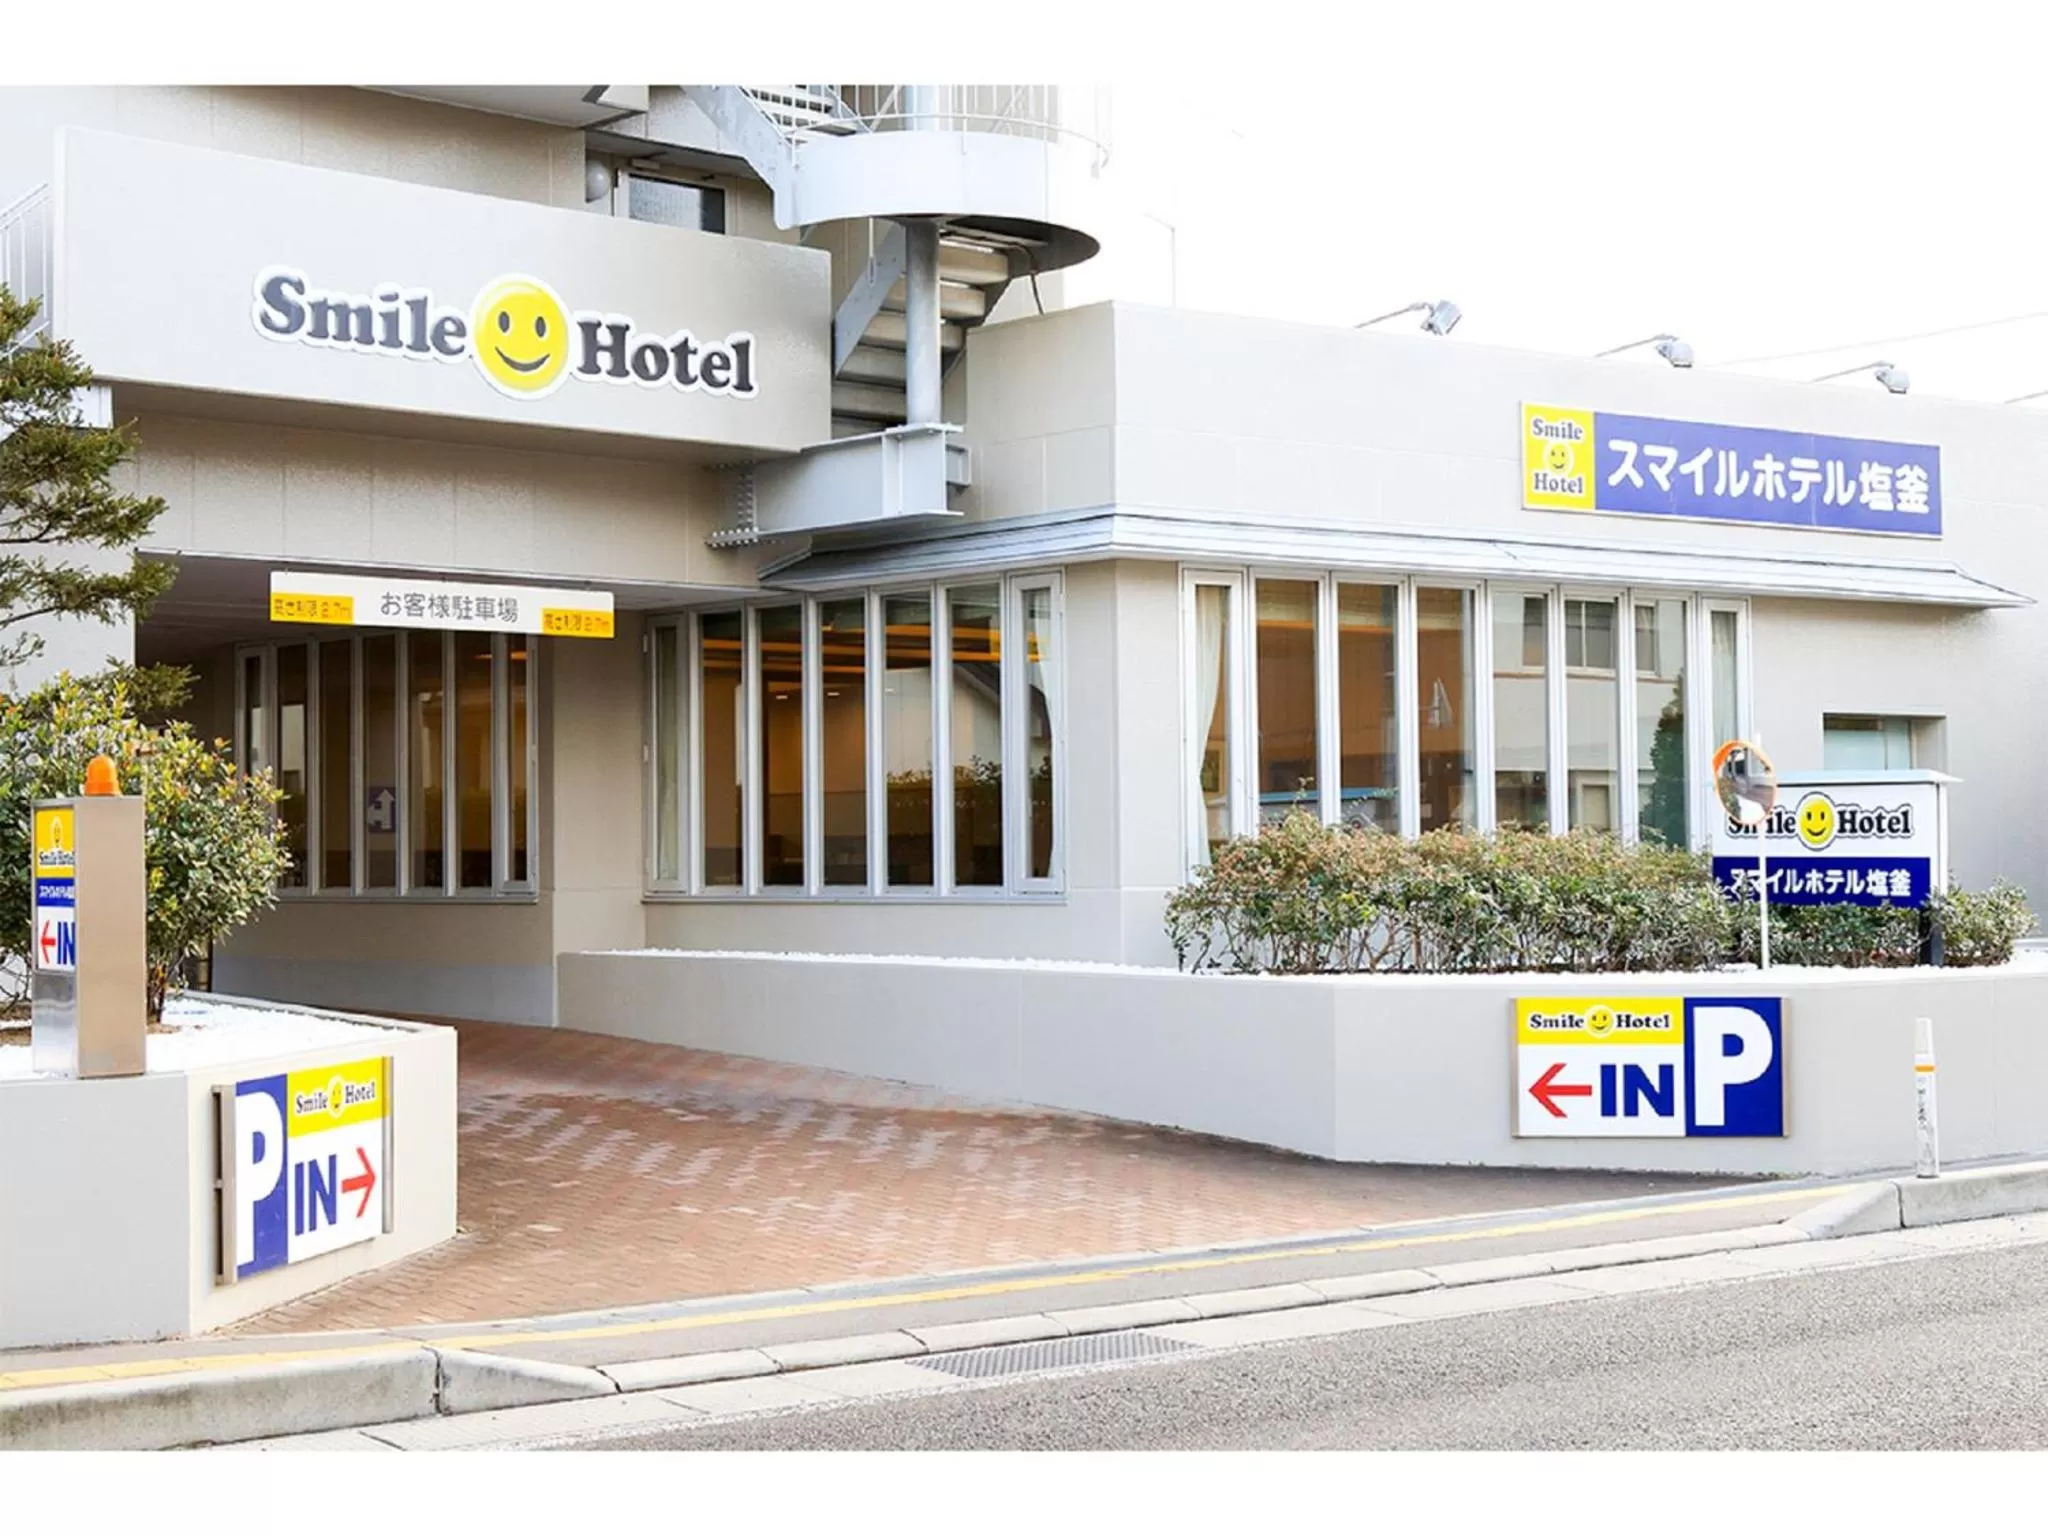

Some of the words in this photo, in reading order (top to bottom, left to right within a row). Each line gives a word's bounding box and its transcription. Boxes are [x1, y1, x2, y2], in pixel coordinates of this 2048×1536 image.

[260, 275, 467, 356] Smile
[576, 320, 755, 392] Hotel
[1532, 418, 1583, 441] Smile
[1533, 473, 1583, 495] Hotel
[1607, 438, 1931, 513] スマイルホテル塩釜
[380, 592, 518, 623] お客様駐車場
[1837, 810, 1911, 835] Hotel
[57, 921, 76, 965] IN
[1530, 1014, 1585, 1029] Smile
[1616, 1014, 1670, 1029] Hotel
[1693, 1006, 1773, 1126] P
[296, 1092, 328, 1114] Smile
[345, 1081, 376, 1104] Hotel
[1600, 1064, 1674, 1117] IN
[236, 1090, 284, 1267] P
[294, 1154, 337, 1237] IN
